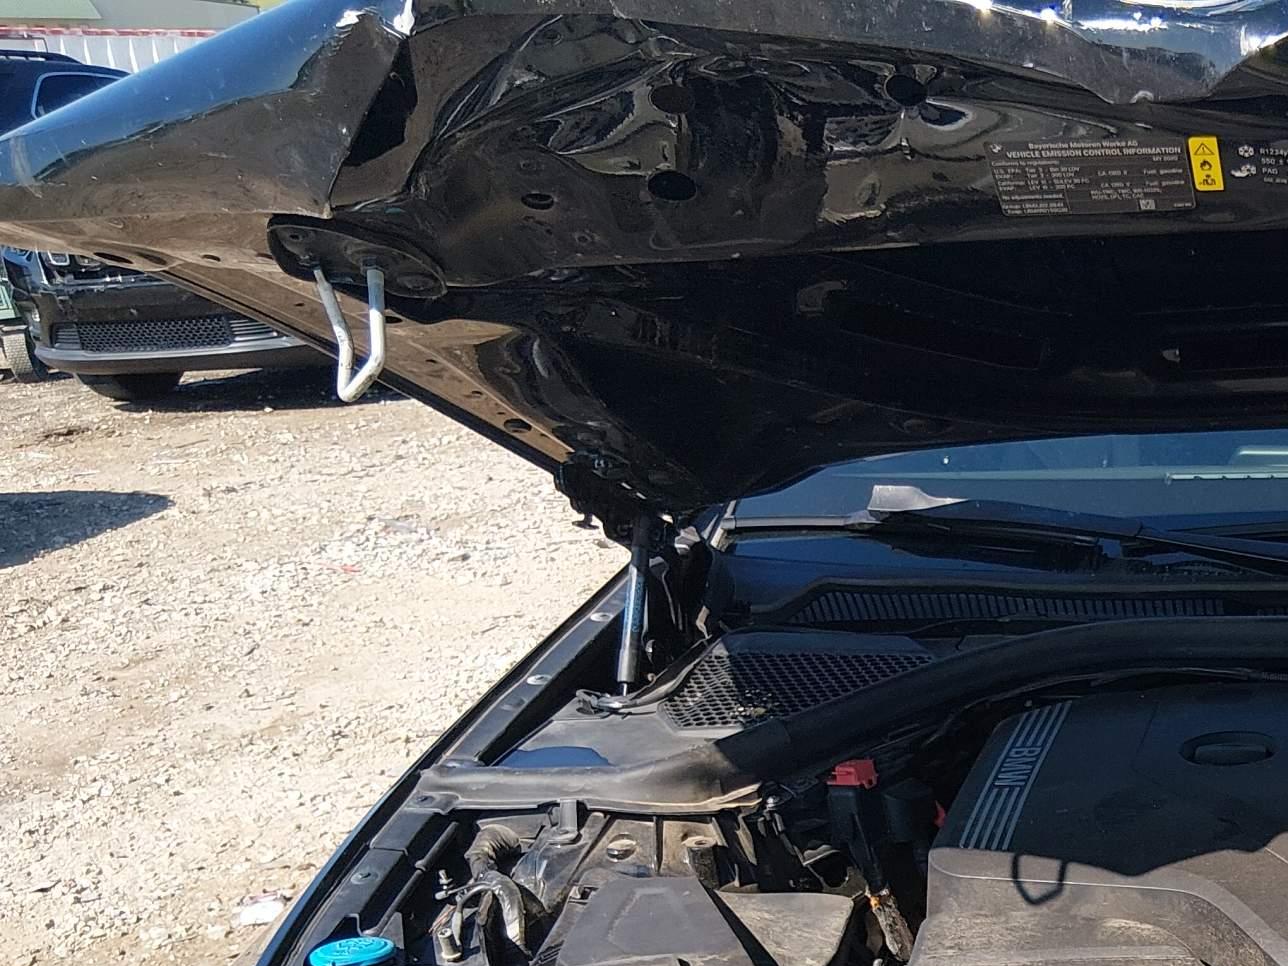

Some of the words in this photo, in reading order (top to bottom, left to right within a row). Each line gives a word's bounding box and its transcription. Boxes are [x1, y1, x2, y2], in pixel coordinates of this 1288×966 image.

[1028, 143, 1068, 151] Bayerische
[1069, 142, 1101, 150] Motoren
[1006, 151, 1041, 159] VEHICLE
[1041, 150, 1082, 158] EMISSION
[1123, 147, 1181, 155] INFORMATION
[1262, 167, 1278, 175] PAG
[994, 747, 1042, 786] BMW
